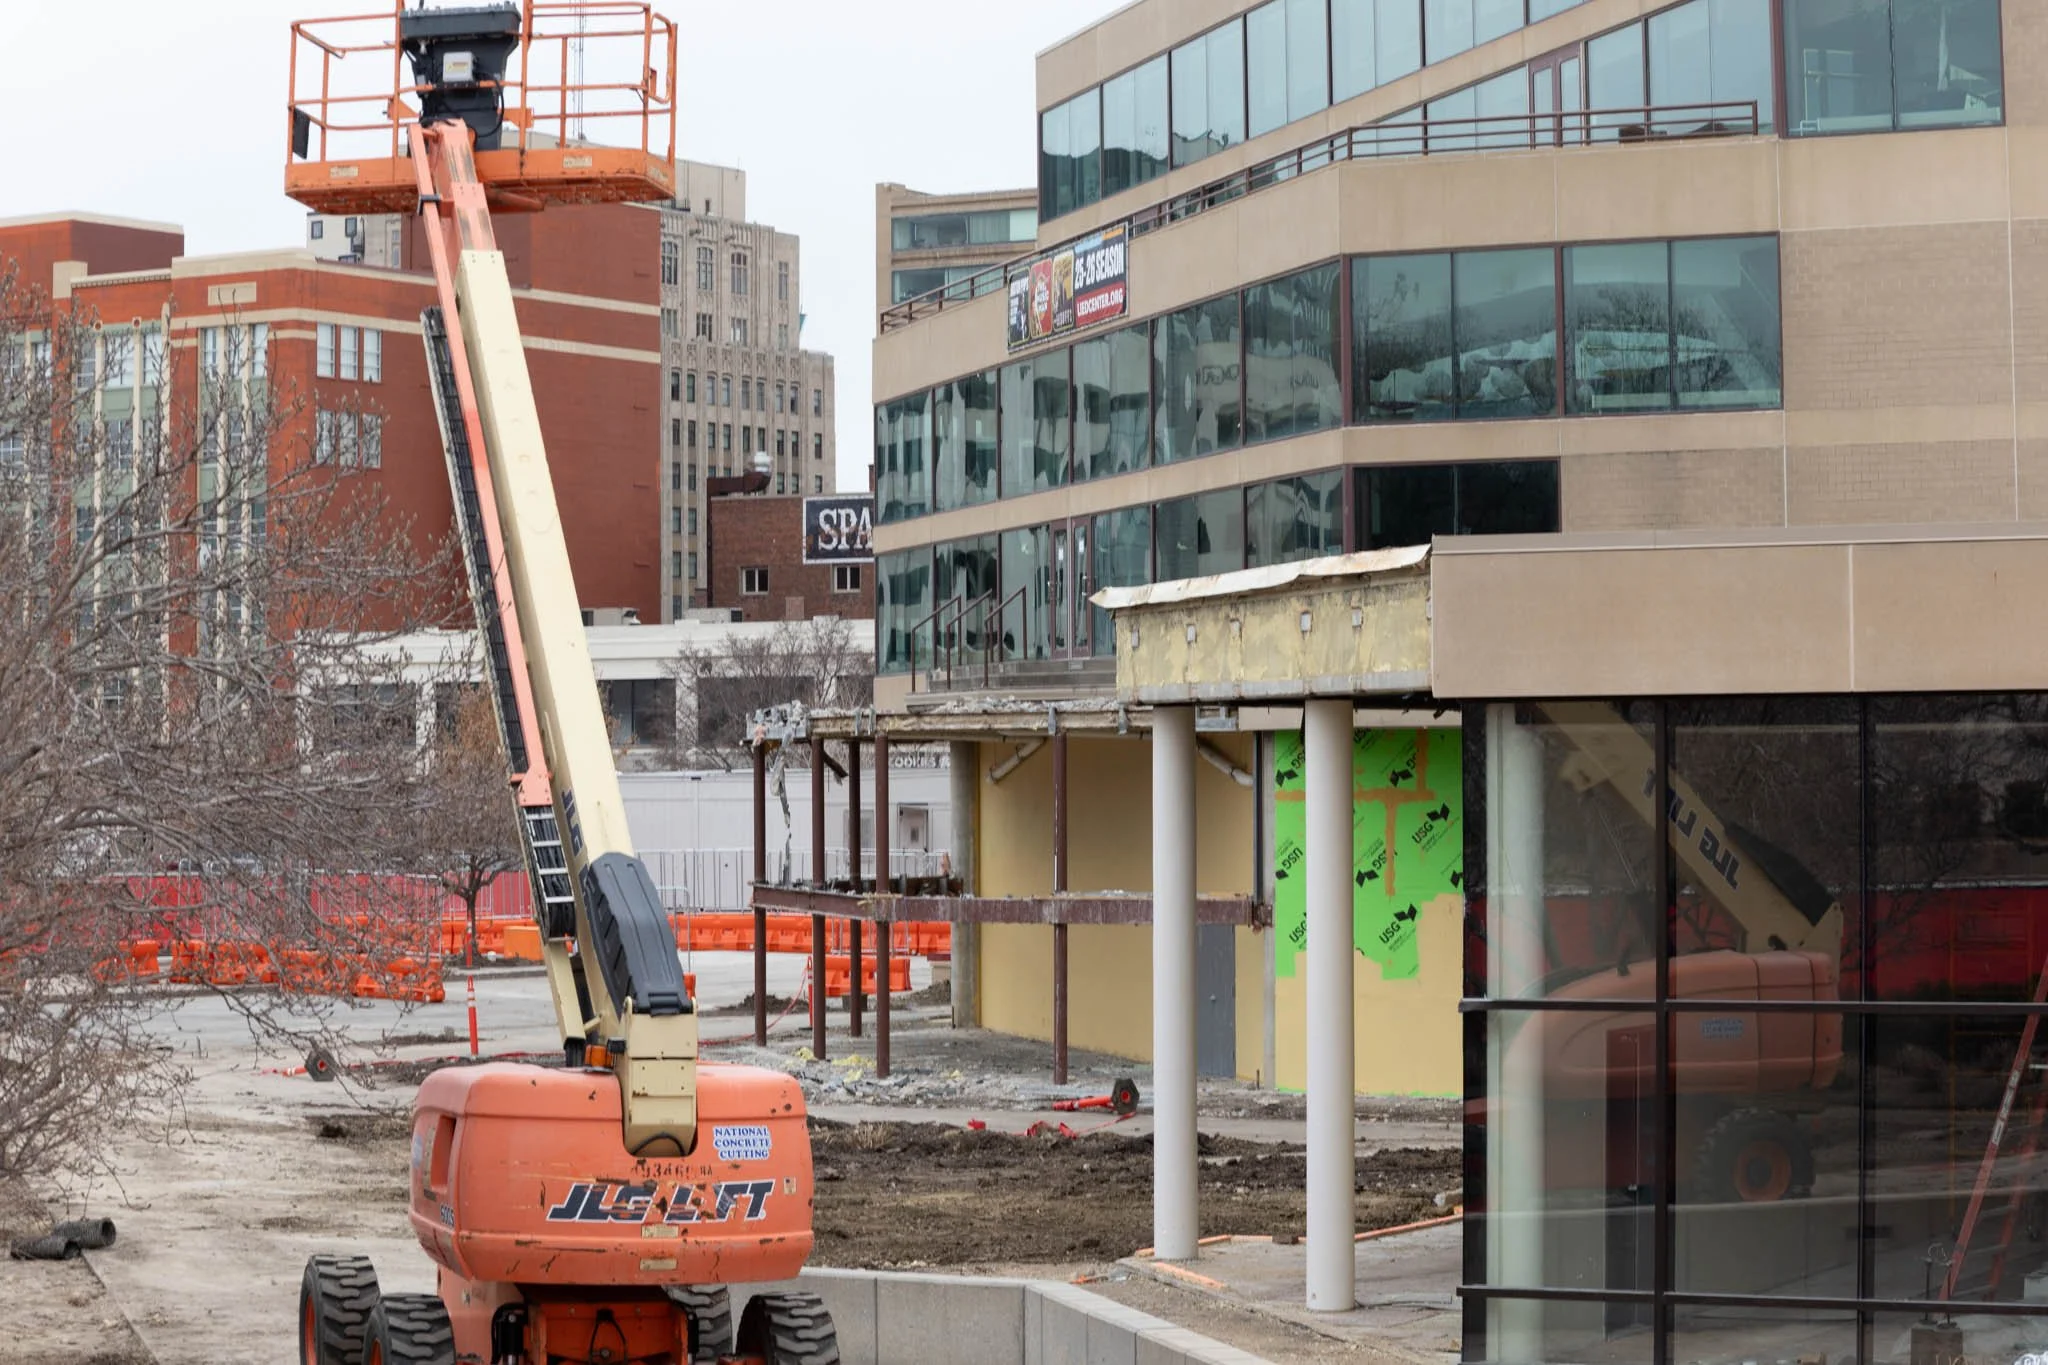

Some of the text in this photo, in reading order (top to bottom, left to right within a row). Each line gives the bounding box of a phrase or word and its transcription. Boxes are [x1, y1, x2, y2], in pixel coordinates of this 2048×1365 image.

[1074, 242, 1124, 290] 25-26 SEASON
[1076, 288, 1123, 317] LIEDCENTER.ORG
[818, 507, 872, 551] SPA
[561, 790, 582, 857] JLG
[1412, 820, 1434, 844] USG
[1282, 847, 1304, 870] USG
[1378, 920, 1401, 945] USG
[715, 1126, 768, 1138] NATIONAL
[715, 1139, 770, 1148] CONCRETE
[720, 1149, 769, 1159] CUTTING
[547, 1179, 776, 1223] JLG LFT
